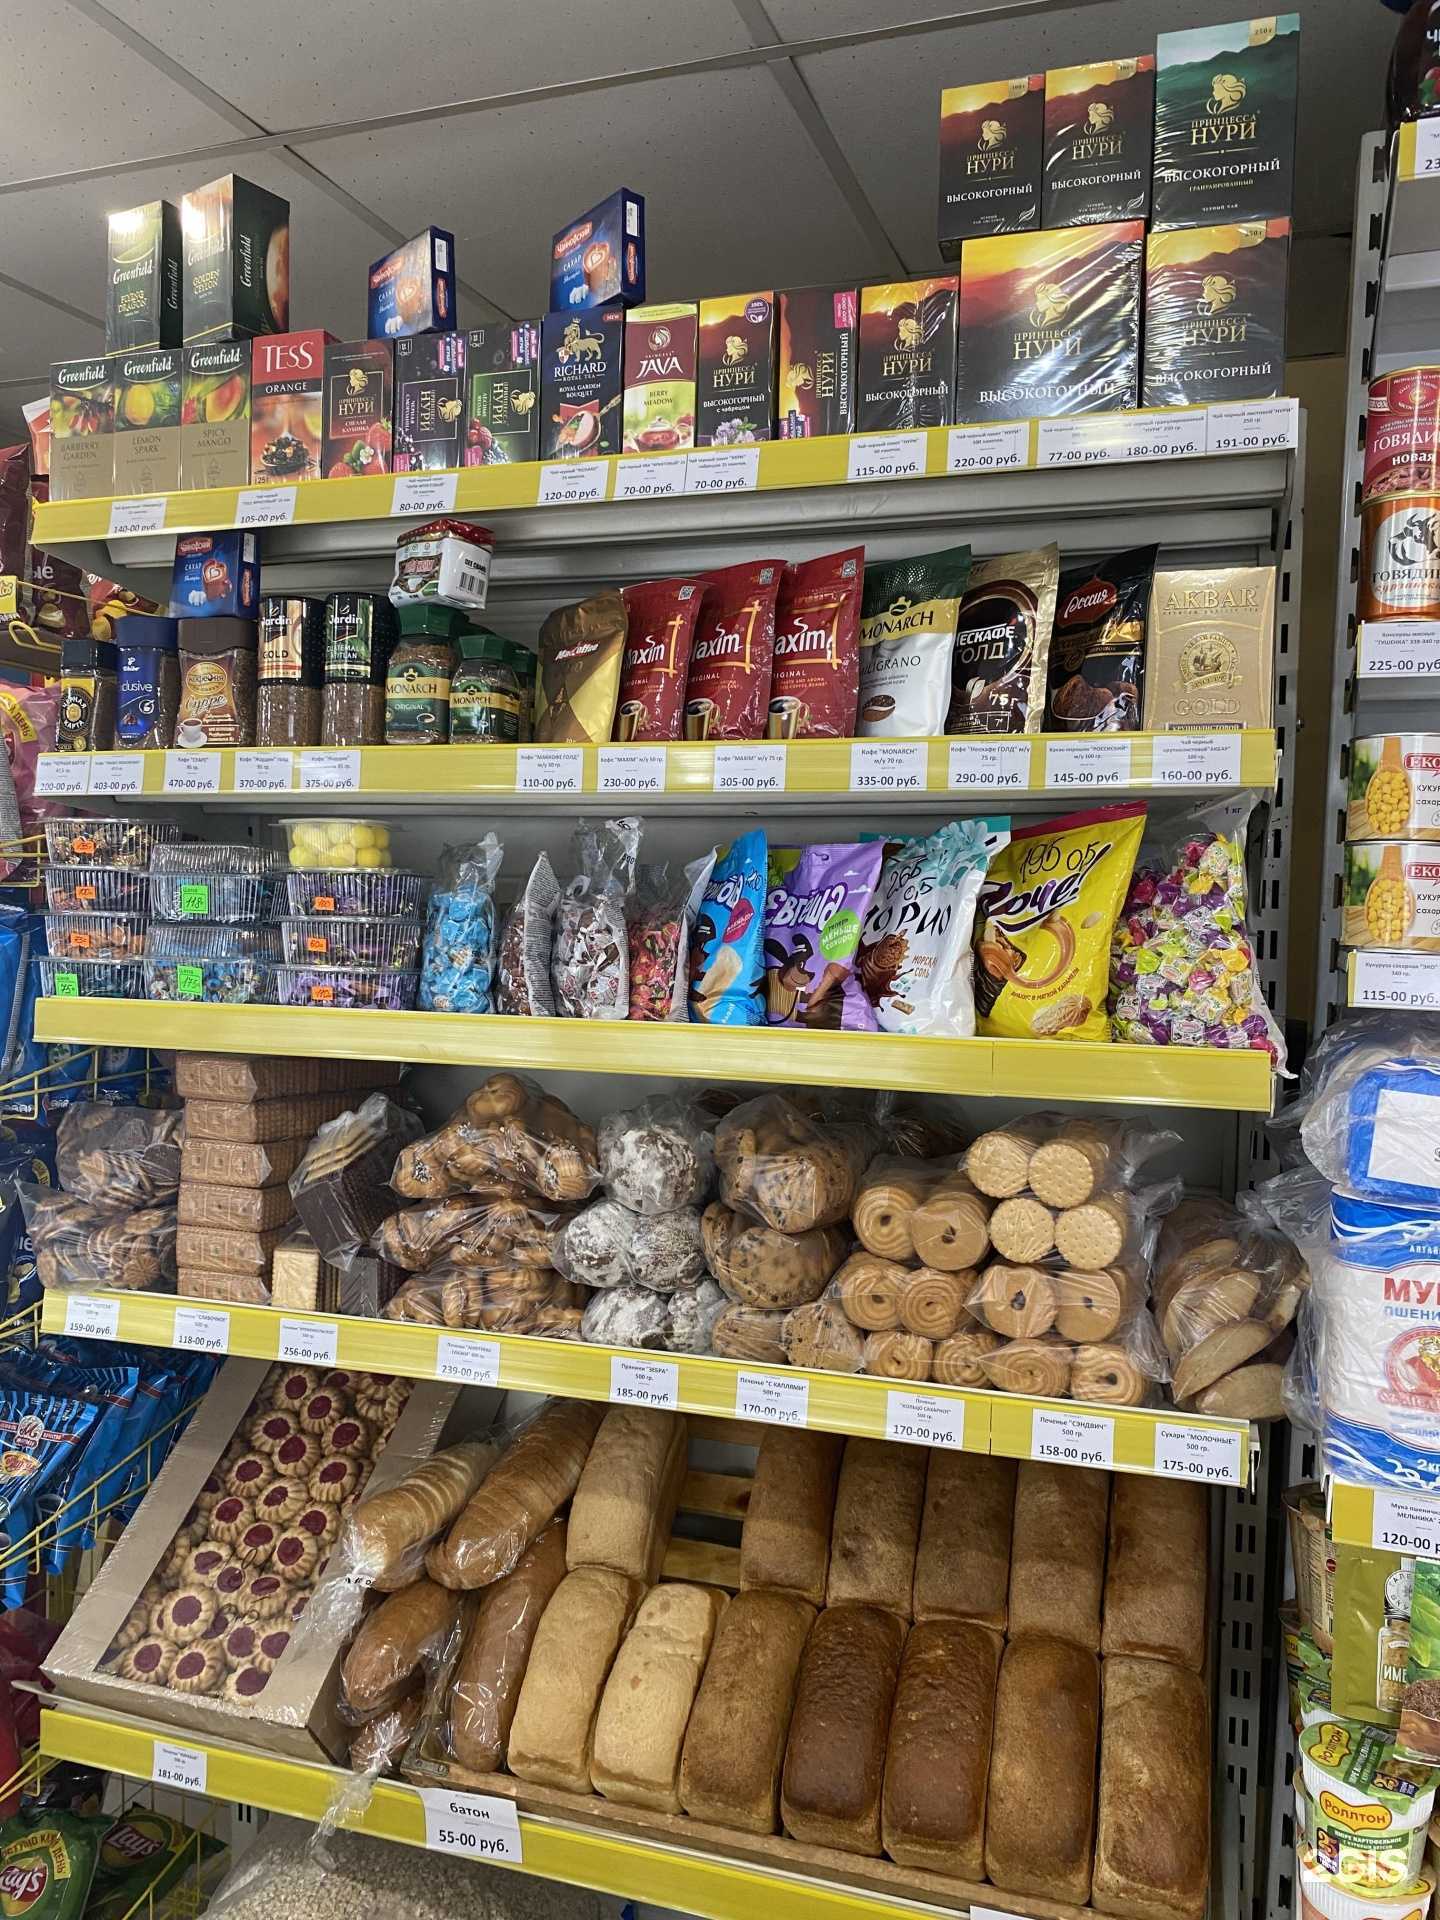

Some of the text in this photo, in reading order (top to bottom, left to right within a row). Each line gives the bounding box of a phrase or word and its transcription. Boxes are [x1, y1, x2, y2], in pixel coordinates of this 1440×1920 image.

[1191, 114, 1257, 129] ПРИНЦЕССА
[1190, 121, 1257, 146] НУРИ
[1071, 140, 1123, 160] НУРИ
[966, 156, 1014, 174] НУРИ
[1163, 158, 1281, 183] ВЫСОКОГОРНЫЙ
[1051, 169, 1141, 190] ВЫСОКОГОРНЫЙ
[946, 184, 1032, 203] ВЫСОКОГОРНЫЙ
[240, 234, 252, 288] Greenfield
[113, 259, 153, 285] Greenfield
[1013, 337, 1081, 360] НУРИ
[191, 348, 240, 368] Greenfield
[262, 341, 314, 373] TESS
[124, 356, 172, 376] Greenfield
[554, 361, 606, 378] RICHARD
[636, 357, 684, 379] JAVA
[883, 358, 931, 376] НУРИ
[1155, 361, 1272, 385] ВЫСОКОГОРНЫЙ
[58, 365, 105, 385] Greenfield
[713, 373, 754, 388] НУРИ
[822, 352, 834, 399] НУРИ
[840, 332, 849, 416] ВЫСОКОГОРНЫЙ
[266, 382, 308, 394] ORANGE
[866, 385, 949, 402] ВЫСОКОГОРНЫЙ
[338, 401, 374, 416] НУРИ
[493, 383, 503, 424] НУРИ
[703, 394, 766, 408] ВЫСОКОГОРНЫЙ
[420, 390, 431, 432] НУРИ
[1126, 442, 1198, 456] 180-00 руб.
[1215, 434, 1290, 449] 191-00 руб.
[954, 454, 1021, 468] 220-00 руб.
[1049, 449, 1110, 462] 77-00 руб.
[1392, 451, 1434, 466] новая
[856, 462, 919, 476] 115-00 руб.
[624, 483, 675, 495] 70-00 руб.
[695, 477, 747, 489] 70-00 руб.
[544, 489, 600, 501] 120-00 руб.
[400, 501, 446, 511] 80-00 руб.
[241, 514, 268, 523] 105-00
[1063, 588, 1109, 618] Россия
[1164, 587, 1258, 610] AKBAR
[261, 615, 292, 625] Jardin
[329, 614, 363, 624] Jardin
[860, 611, 934, 641] MONARCH
[776, 626, 825, 654] axim
[263, 650, 289, 659] GOLD
[1369, 660, 1414, 671] 225-00
[386, 683, 437, 694] MONARCH
[453, 696, 491, 705] MONARCH
[991, 693, 1009, 707] 75
[1175, 698, 1240, 716] GOLD
[523, 777, 577, 788] 110-00 руб.
[603, 777, 659, 788] 230-00 руб.
[720, 776, 779, 788] 305-00 руб.
[857, 775, 920, 787] 335-00 руб.
[955, 773, 1022, 785] 290-00 руб.
[1053, 773, 1093, 783] 145-00
[1161, 769, 1232, 782] 160-00 руб.
[94, 781, 119, 790] 403-00
[169, 779, 215, 790] 470-00 руб.
[239, 778, 287, 790] 370-00 руб.
[305, 777, 354, 790] 375-00 руб.
[1231, 807, 1242, 815] кг
[822, 924, 860, 945] МЕНЬШЕ
[1363, 990, 1439, 1005] 115-00 руб.
[69, 1323, 112, 1336] 159-00 руб.
[178, 1335, 224, 1349] 118-00 руб.
[284, 1346, 331, 1361] 256-00 руб.
[442, 1364, 472, 1377] 239-00
[616, 1387, 649, 1400] 185-00
[743, 1403, 801, 1422] 170-00 руб.
[1039, 1415, 1107, 1431] Печенье "СЭНДВИЧ"
[893, 1424, 956, 1443] 170-00 руб.
[1062, 1428, 1074, 1436] 500
[1161, 1430, 1236, 1445] Сухари "МОЛОЧНЫЕ"
[1039, 1444, 1106, 1463] 158-00 руб.
[1186, 1442, 1198, 1450] 500
[1162, 1459, 1233, 1479] 175-00 руб.
[1382, 1532, 1431, 1550] 120-00
[158, 1768, 202, 1787] 181-00 руб.
[449, 1802, 490, 1820] батон
[106, 1824, 161, 1856] Lay's
[439, 1829, 509, 1854] 55-00 руб.
